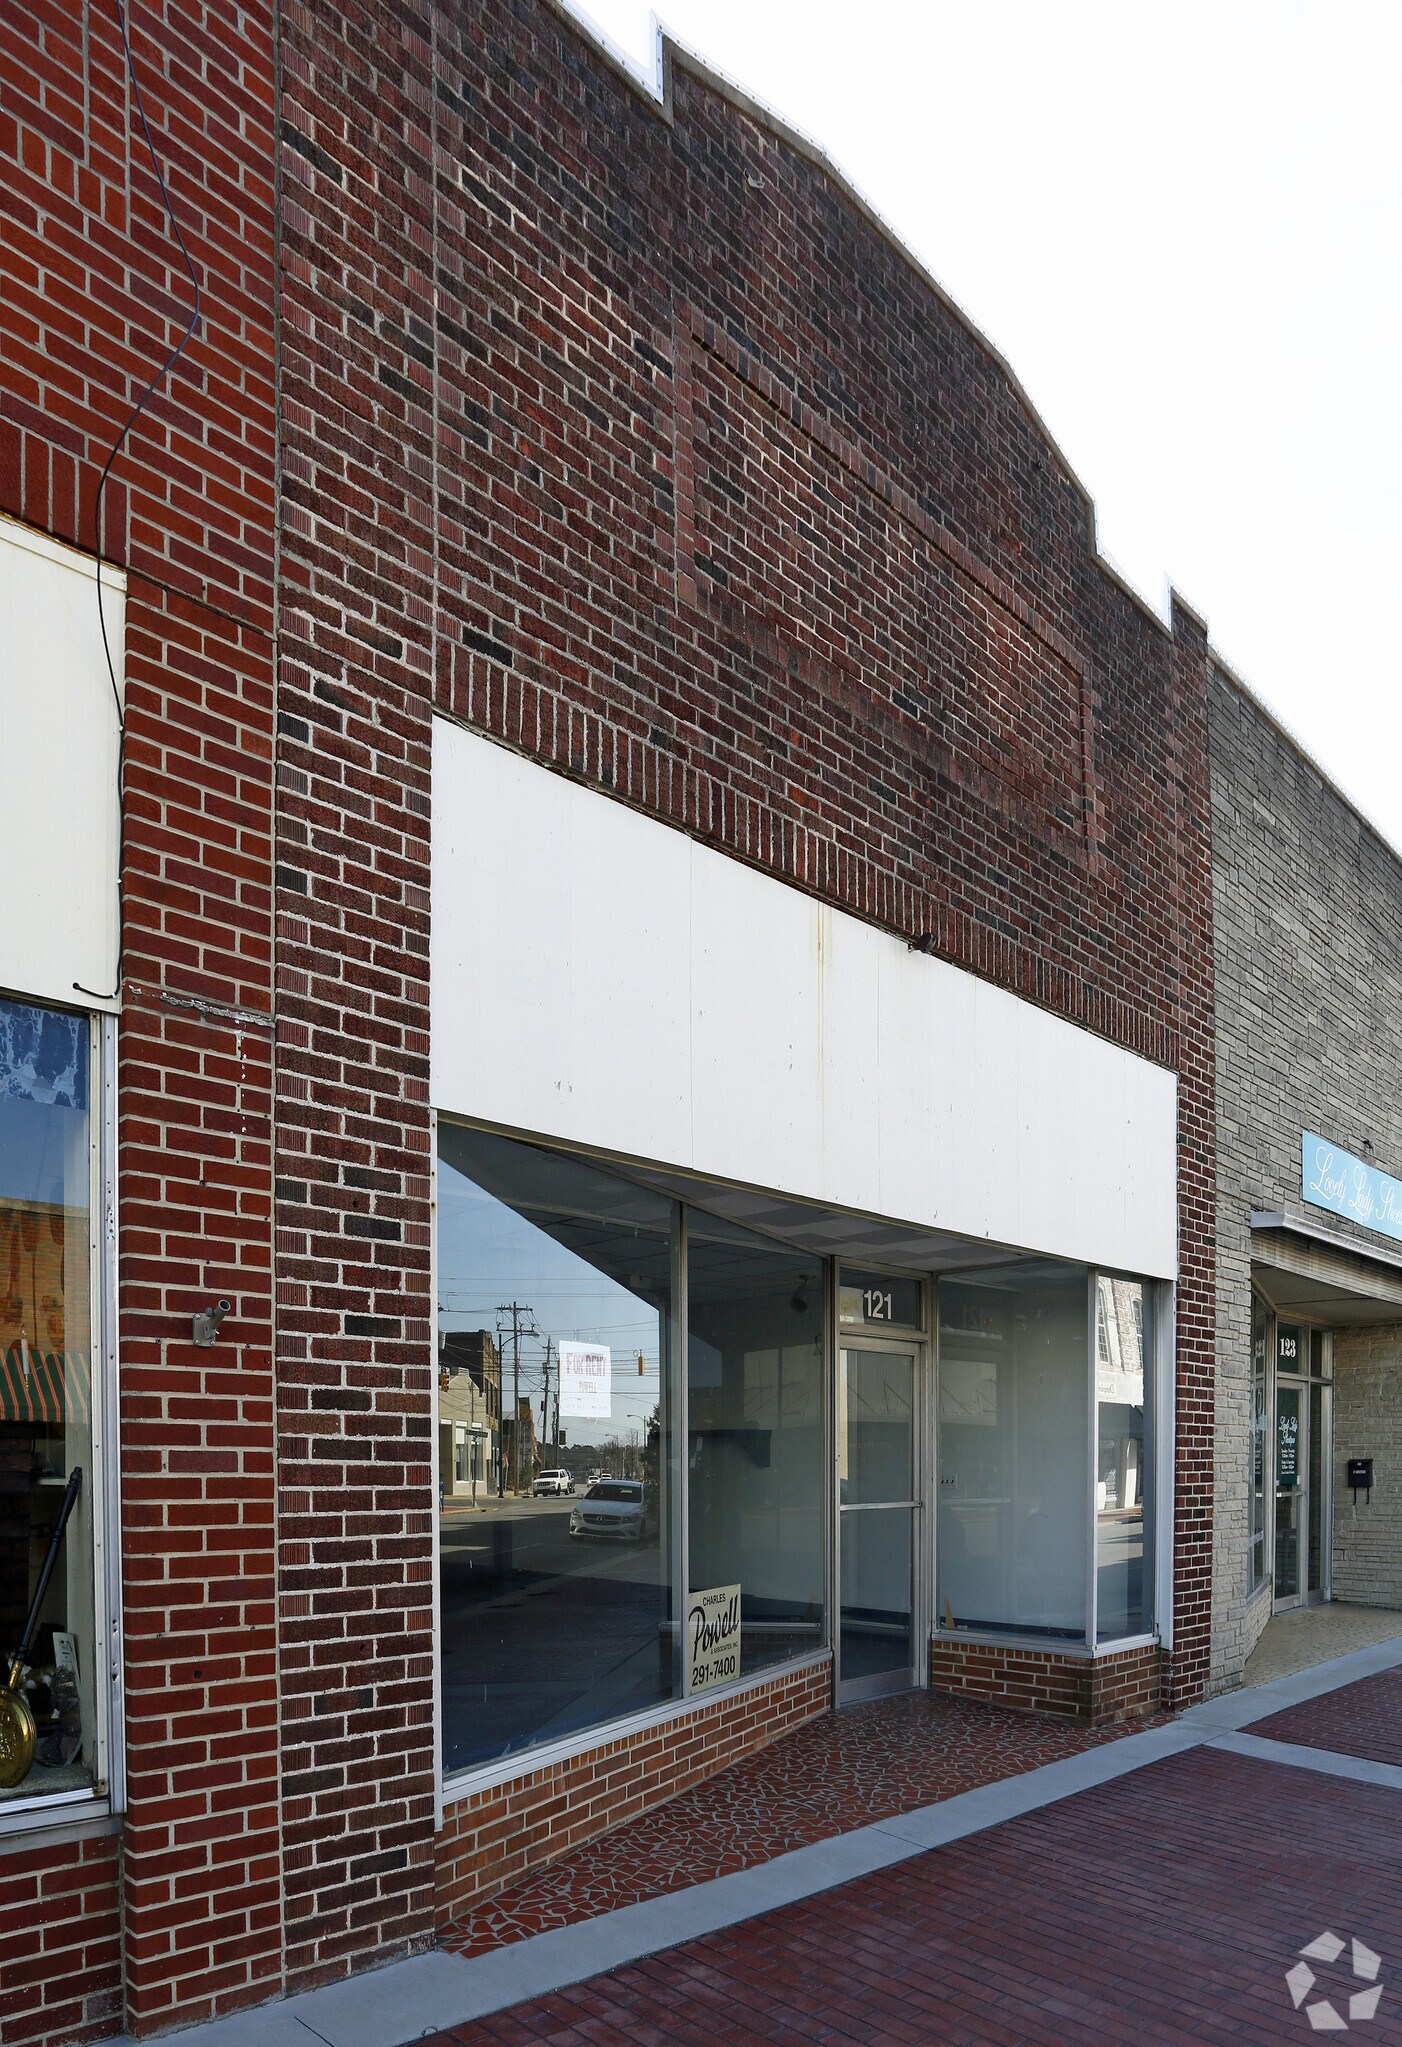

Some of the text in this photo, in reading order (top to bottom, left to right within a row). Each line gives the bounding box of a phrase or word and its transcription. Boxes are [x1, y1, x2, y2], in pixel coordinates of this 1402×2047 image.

[1310, 1146, 1346, 1208] Lovely
[1348, 1165, 1374, 1222] Lady
[863, 1289, 892, 1320] 121
[1279, 1337, 1297, 1358] 123
[566, 1352, 607, 1377] FOR RENT
[702, 1592, 727, 1607] CHARLES
[688, 1593, 740, 1663] Powell
[691, 1655, 736, 1687] 291-7400
